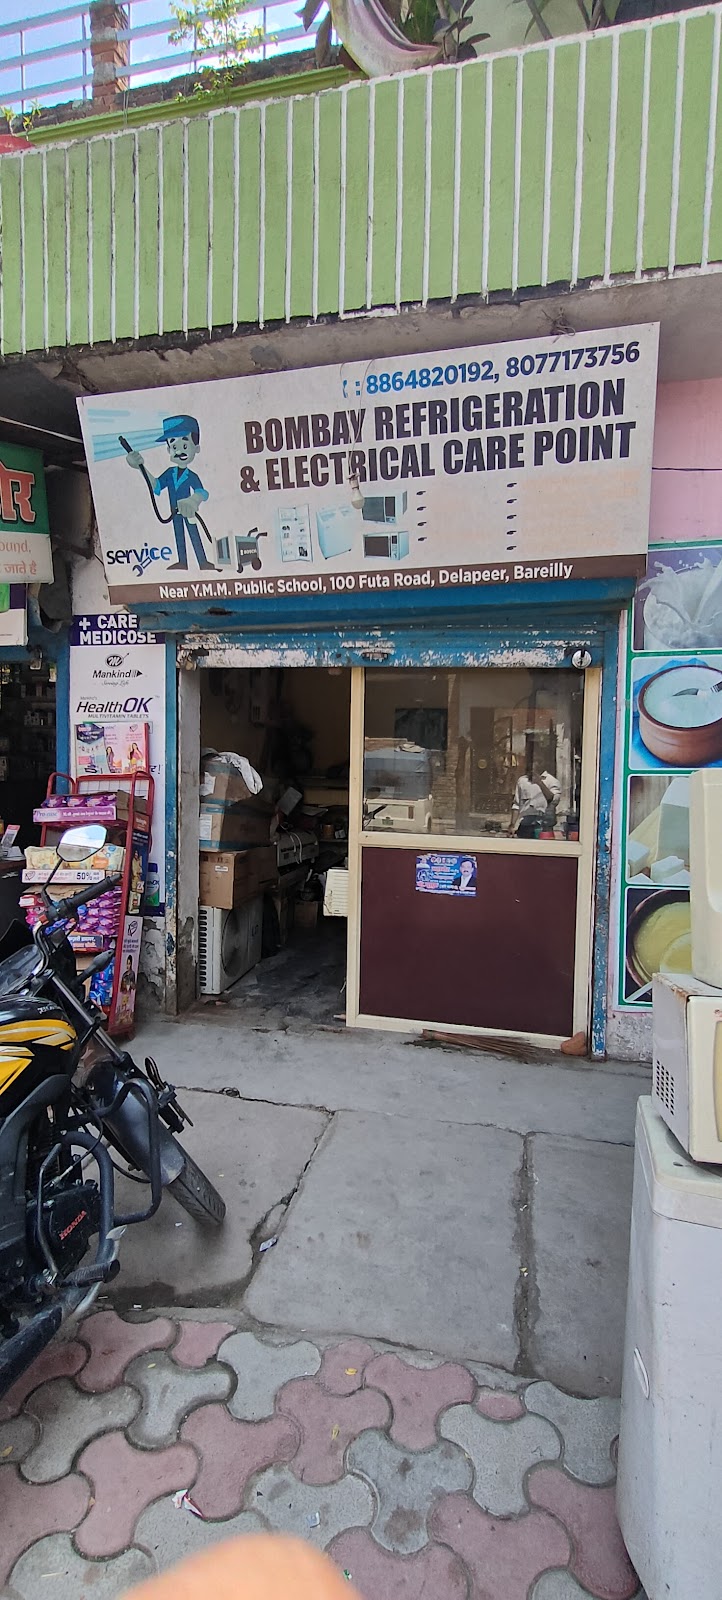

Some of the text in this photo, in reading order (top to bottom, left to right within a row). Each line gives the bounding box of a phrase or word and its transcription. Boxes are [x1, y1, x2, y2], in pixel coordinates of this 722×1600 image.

[366, 360, 500, 395] 8864820192,
[506, 341, 640, 378] 8077173756
[244, 378, 626, 454] BOMBAY REFRIGERATION
[240, 421, 637, 494] & ELECTRICAL CARE POINT
[106, 543, 172, 565] service
[159, 562, 573, 599] Near Y.M.M. Public School, 100 Futa Road, Delapeer, Bareilly
[97, 614, 138, 630] CARE
[80, 630, 157, 645] MEDICOSE
[92, 669, 132, 679] Mankind
[76, 697, 153, 713] HealthOK
[58, 1210, 87, 1240] HONDA
